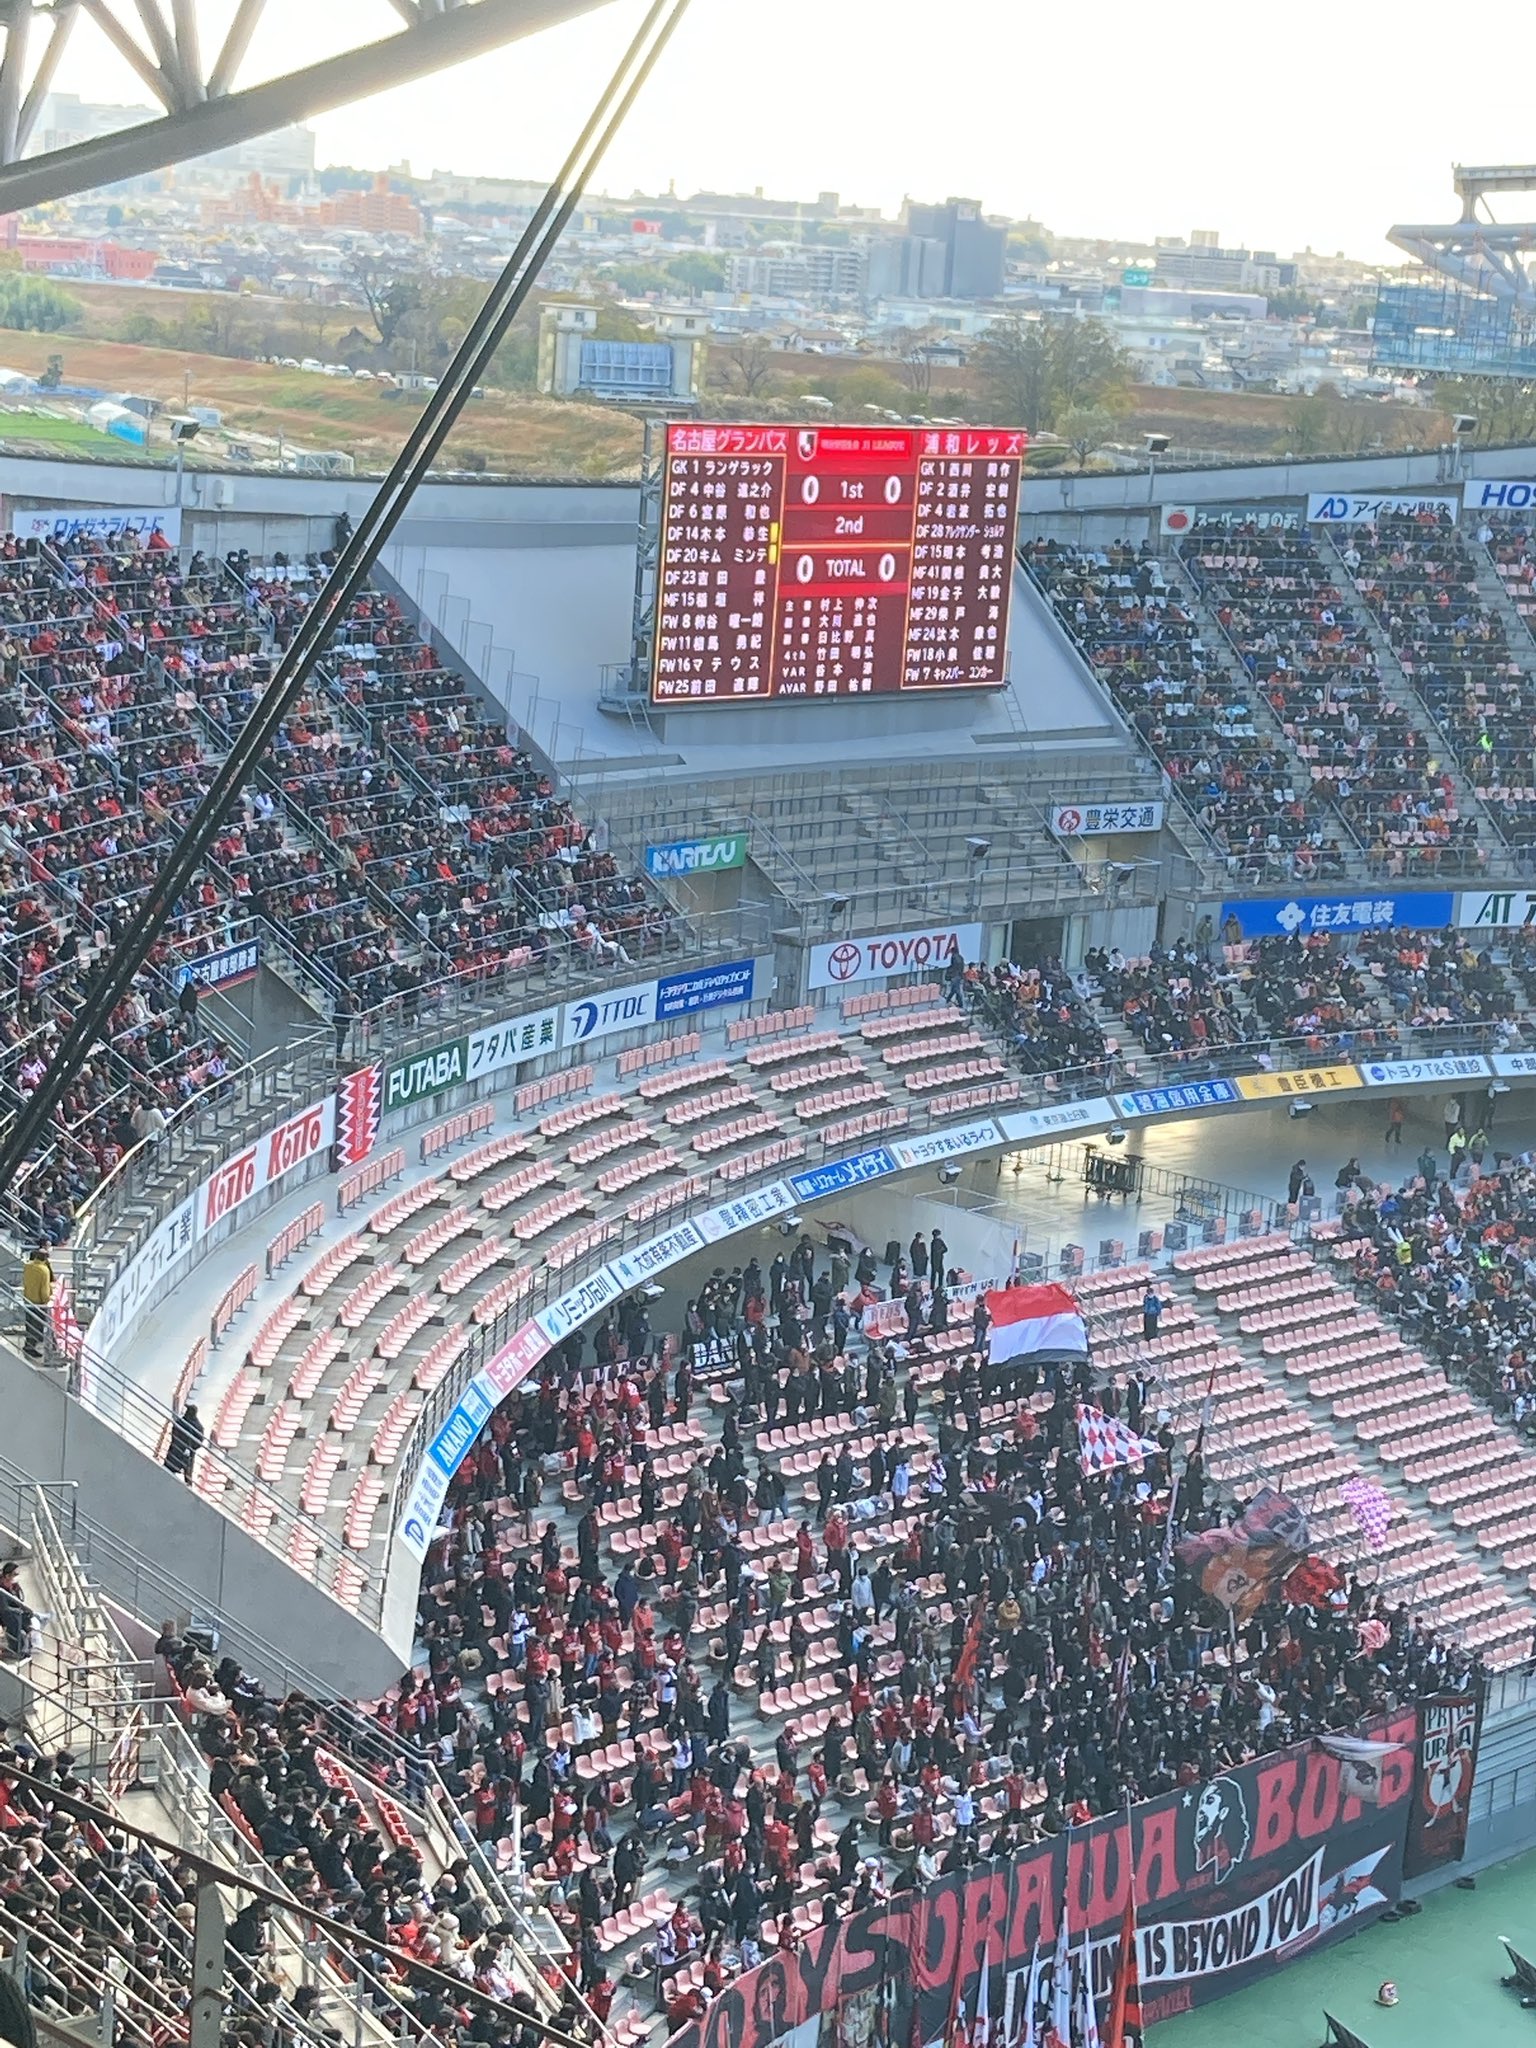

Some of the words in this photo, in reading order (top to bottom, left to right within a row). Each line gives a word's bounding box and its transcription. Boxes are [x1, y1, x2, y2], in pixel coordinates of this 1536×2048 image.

[672, 429, 787, 451] 名古屋グランパス
[924, 433, 1021, 454] 浦和レッズ
[672, 460, 688, 475] GK
[693, 459, 699, 474] 1
[705, 460, 773, 475] ランゲラック
[920, 462, 935, 476] GK
[940, 462, 945, 475] 1
[670, 482, 686, 496] DF
[690, 482, 699, 496] 4
[802, 476, 819, 504] 0
[840, 480, 864, 499] 1st
[885, 476, 901, 504] 0
[920, 482, 933, 496] DF
[937, 482, 944, 496] 2
[669, 504, 684, 519] DF
[689, 505, 698, 518] 6
[917, 504, 931, 517] DF
[935, 504, 943, 517] 4
[835, 516, 863, 534] 2nd
[916, 525, 930, 538] DF
[668, 527, 683, 541] DF
[685, 526, 699, 540] 14
[700, 527, 726, 542] 木本
[666, 549, 682, 563] DF
[684, 548, 698, 562] 20
[699, 549, 721, 564] キム
[734, 548, 767, 563] ミンテ
[914, 545, 928, 559] DF
[930, 545, 941, 558] 15
[796, 554, 813, 583] 0
[826, 559, 866, 577] TOTAL
[878, 553, 895, 582] 0
[912, 566, 927, 579] MF
[927, 565, 939, 579] 41
[665, 570, 680, 585] DF
[682, 570, 696, 584] 23
[664, 593, 680, 607] MF
[682, 592, 694, 606] 15
[912, 586, 926, 600] MF
[927, 586, 939, 599] 19
[940, 585, 963, 601] 金子
[662, 615, 679, 629] FW
[682, 614, 691, 629] 8
[910, 607, 924, 621] MF
[925, 606, 937, 620] 29
[908, 628, 922, 641] MF
[923, 627, 935, 640] 24
[660, 637, 677, 651] FW
[679, 636, 690, 650] 11
[907, 648, 921, 662] FW
[922, 648, 934, 661] 18
[659, 659, 676, 673] FW
[678, 658, 690, 672] 16
[692, 656, 759, 672] マテウス
[782, 666, 806, 678] VAR
[905, 668, 920, 681] FW
[923, 667, 931, 680] 7
[658, 680, 674, 694] FW
[675, 680, 689, 693] 25
[779, 682, 806, 694] AVAR
[1084, 806, 1154, 831] 豊栄交通
[1310, 901, 1395, 927] 住友電装
[867, 933, 959, 971] TOYOTA
[601, 993, 649, 1025] TTDC
[472, 1018, 554, 1070] フタバ産業
[388, 1047, 461, 1105] FUTABA
[1387, 1059, 1482, 1080] トヨタT&S建設
[911, 1128, 994, 1160] トヨタすまいるライフ
[119, 1205, 193, 1325] トリニティ工業
[556, 1277, 614, 1327] ソミック石川
[436, 1412, 473, 1468] AMANO
[906, 1808, 1182, 1991] URAWA
[1143, 1925, 1167, 1977] IS
[1172, 1905, 1260, 1973] BEYOND
[1264, 1861, 1315, 1950] YOU
